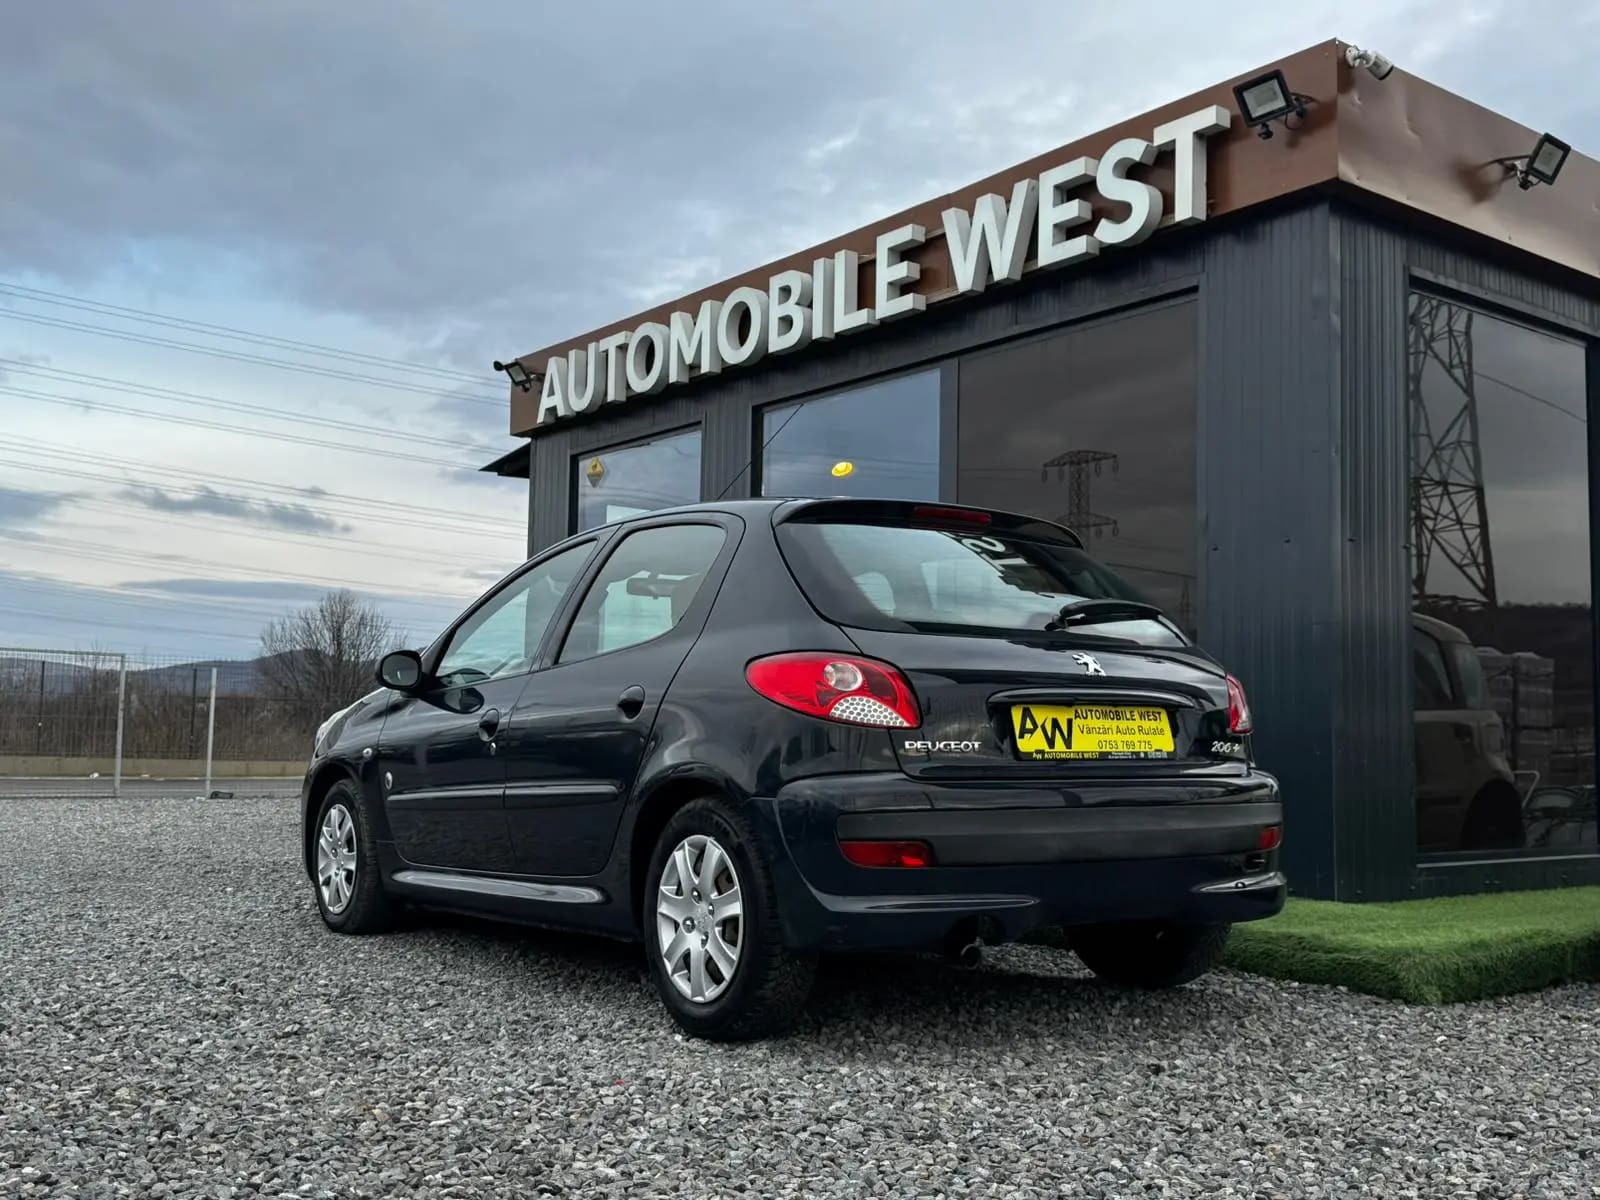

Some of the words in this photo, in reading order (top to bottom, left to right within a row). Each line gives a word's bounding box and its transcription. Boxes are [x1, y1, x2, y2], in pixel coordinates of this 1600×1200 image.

[536, 223, 927, 425] AUTOMOBILE
[941, 104, 1231, 296] WEST
[1074, 708, 1136, 722] AUTOMOBILE
[1137, 710, 1162, 722] WEST
[1116, 725, 1136, 736] Auto
[1137, 725, 1165, 736] Rulate
[904, 740, 982, 753] PEUGEOT
[1097, 740, 1119, 750] 0753
[1121, 741, 1135, 750] 769
[1137, 741, 1153, 750] 775
